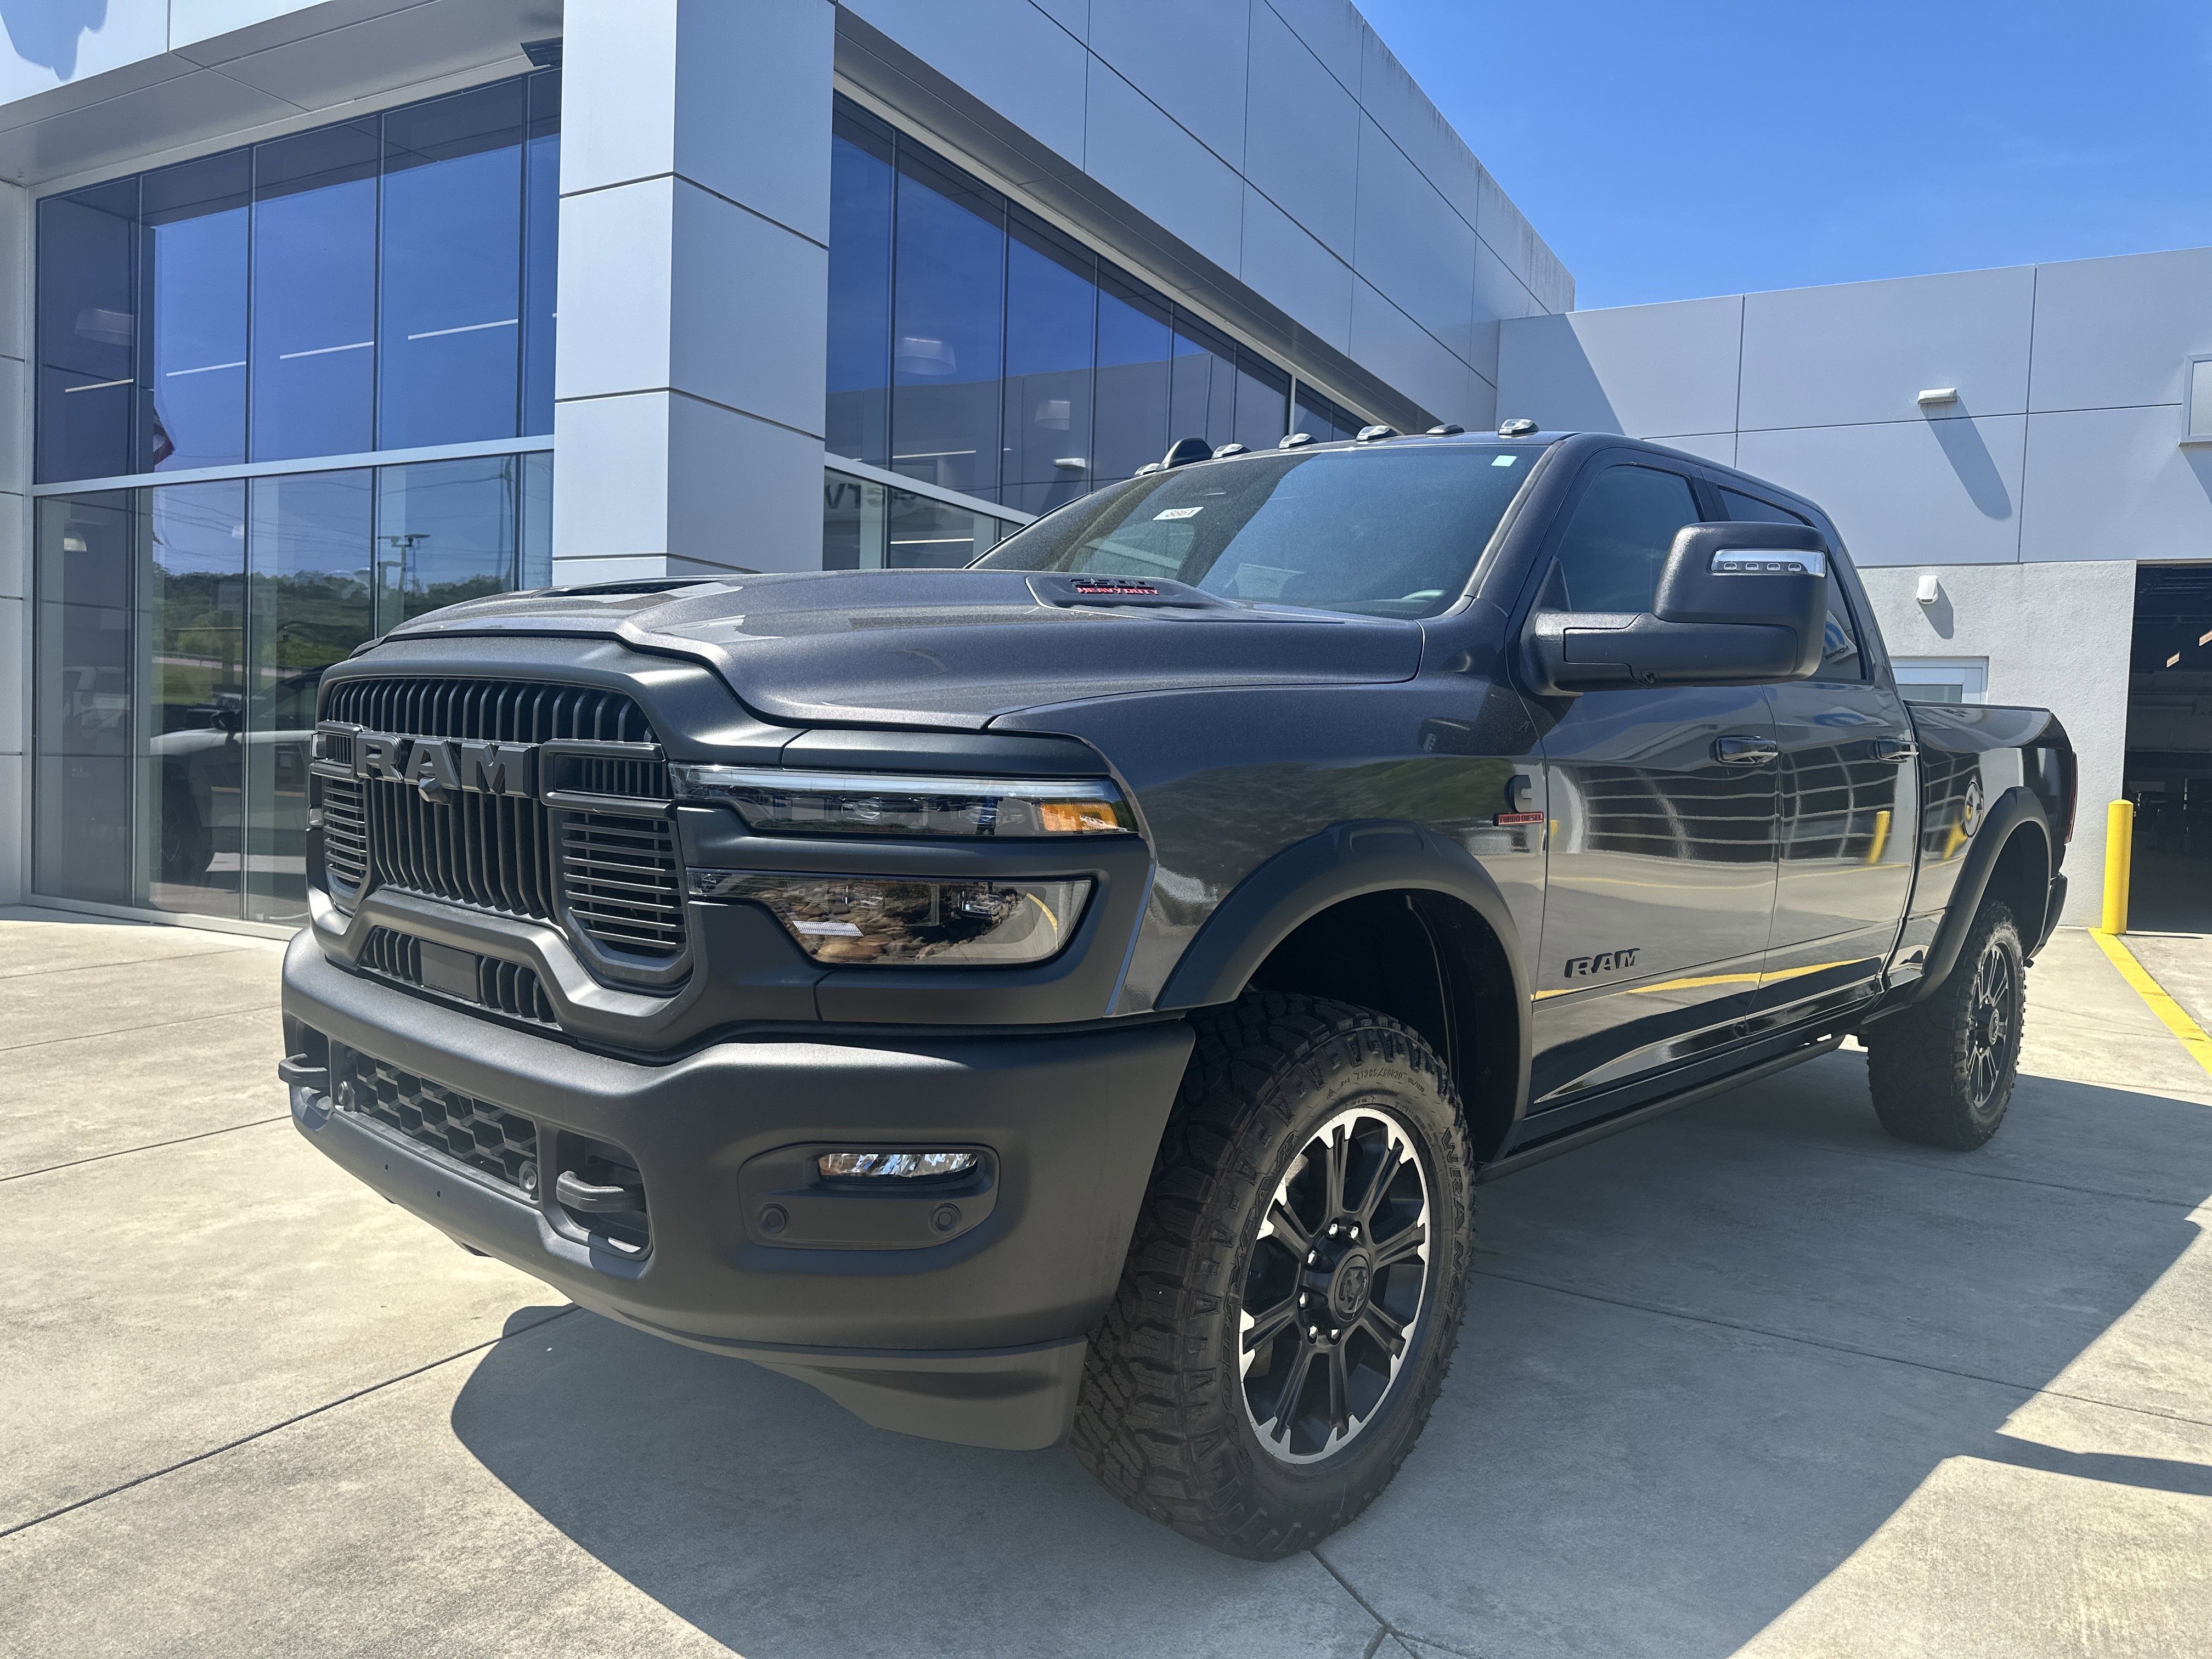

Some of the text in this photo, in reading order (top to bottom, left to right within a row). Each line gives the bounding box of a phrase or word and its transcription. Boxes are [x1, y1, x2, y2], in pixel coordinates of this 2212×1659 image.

[356, 732, 539, 798] RAM
[1521, 814, 1543, 822] DIESEL
[1564, 948, 1640, 978] RAM
[1221, 1131, 1295, 1476] GOODYEAR
[1410, 1127, 1465, 1420] WRANGLER
